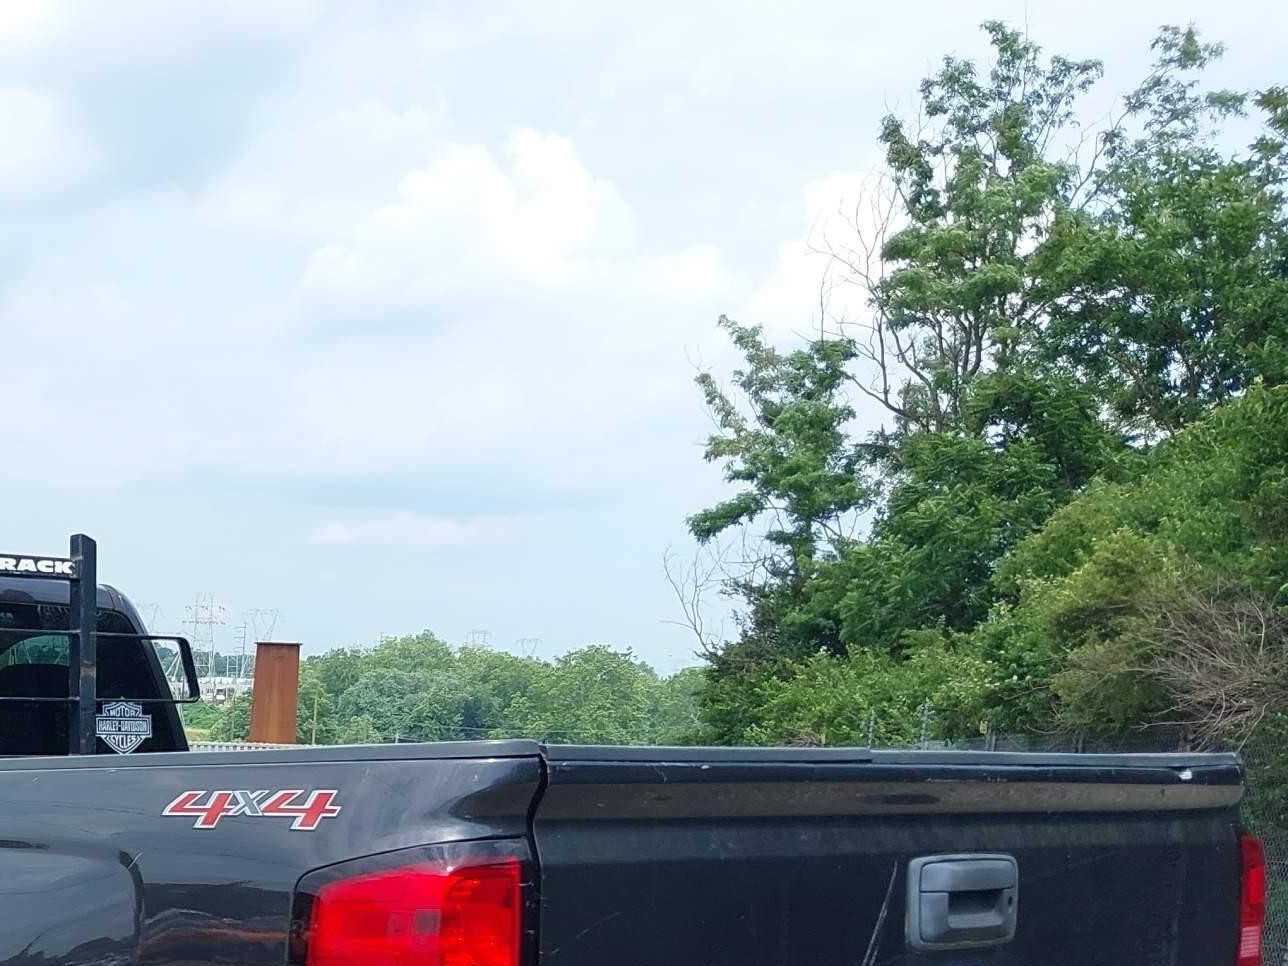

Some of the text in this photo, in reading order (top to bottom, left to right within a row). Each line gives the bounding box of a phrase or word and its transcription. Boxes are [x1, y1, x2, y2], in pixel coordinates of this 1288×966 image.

[109, 706, 137, 718] MOTOR
[98, 720, 147, 732] HARLEY-DAVIDSON
[111, 735, 136, 748] CYCLES
